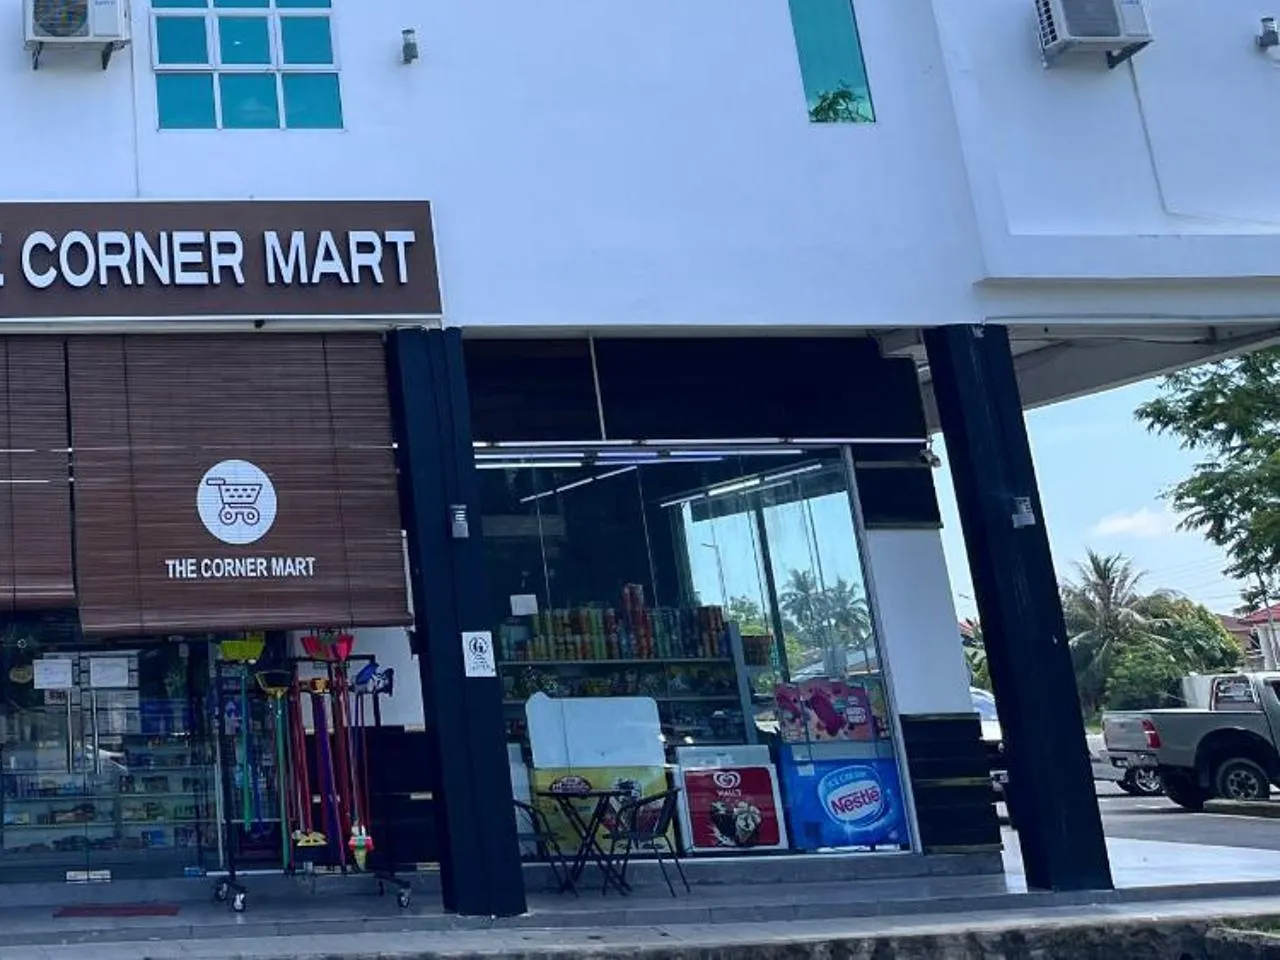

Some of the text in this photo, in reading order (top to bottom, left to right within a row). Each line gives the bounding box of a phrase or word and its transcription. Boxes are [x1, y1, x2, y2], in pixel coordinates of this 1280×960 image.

[21, 230, 245, 288] CORNER
[263, 230, 416, 285] MART
[165, 556, 316, 579] THE CORNER MART
